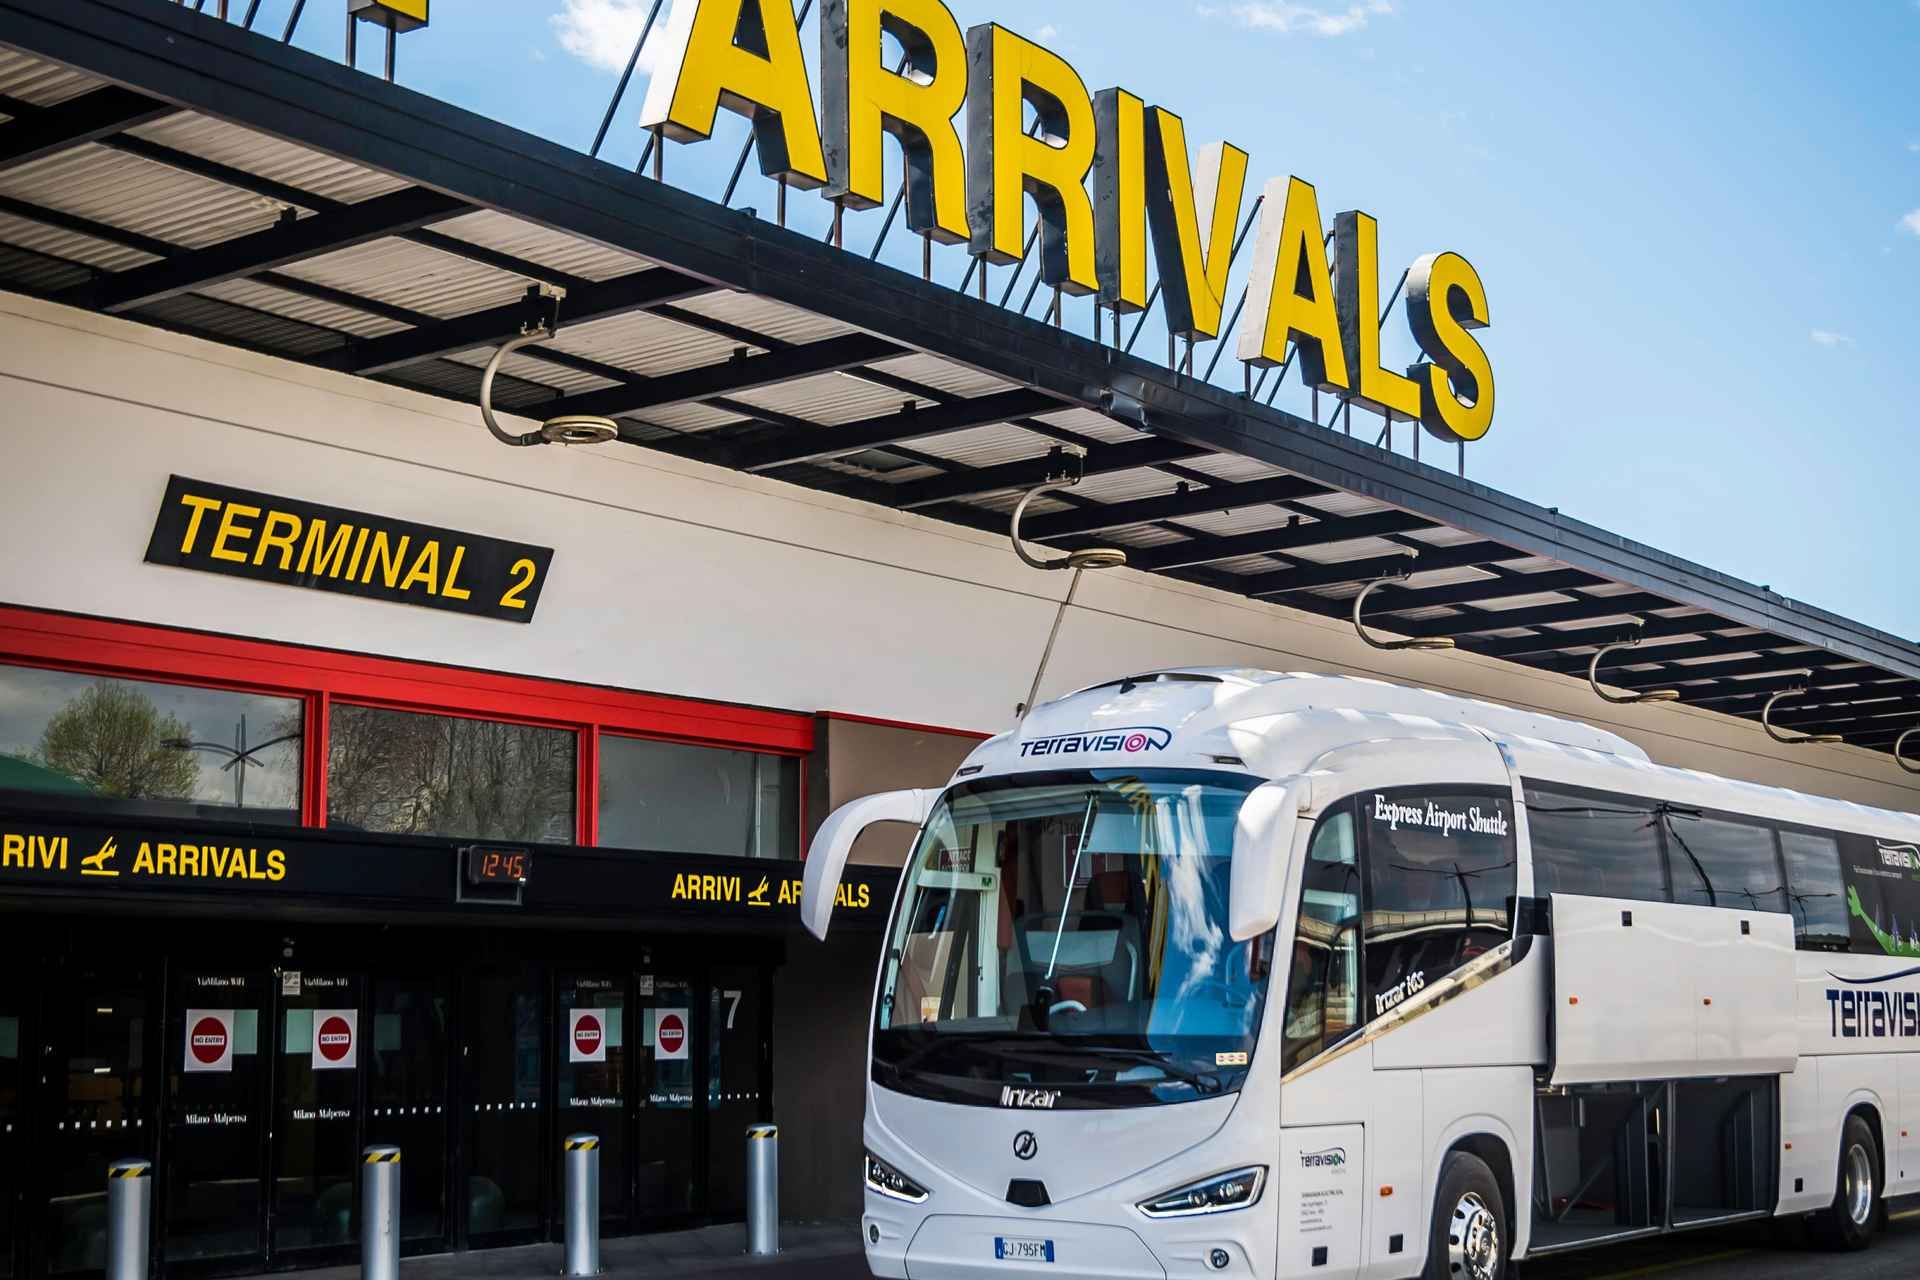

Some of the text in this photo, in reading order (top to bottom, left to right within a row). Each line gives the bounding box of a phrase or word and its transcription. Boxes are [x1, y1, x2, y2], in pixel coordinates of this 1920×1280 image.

[640, 0, 1495, 442] ARRIVALS
[179, 494, 537, 609] TERMINAL 2
[1374, 794, 1508, 837] Express Airport Shuttle
[2, 834, 286, 881] RIVI ARRIVALS
[671, 873, 870, 908] ARRIVI ARALS
[723, 989, 742, 1029] 7
[195, 1036, 224, 1045] NO ENTRY
[321, 1035, 330, 1043] NO
[185, 1112, 247, 1125] Milano Malpensa
[292, 1108, 351, 1120] Milano Malpensa
